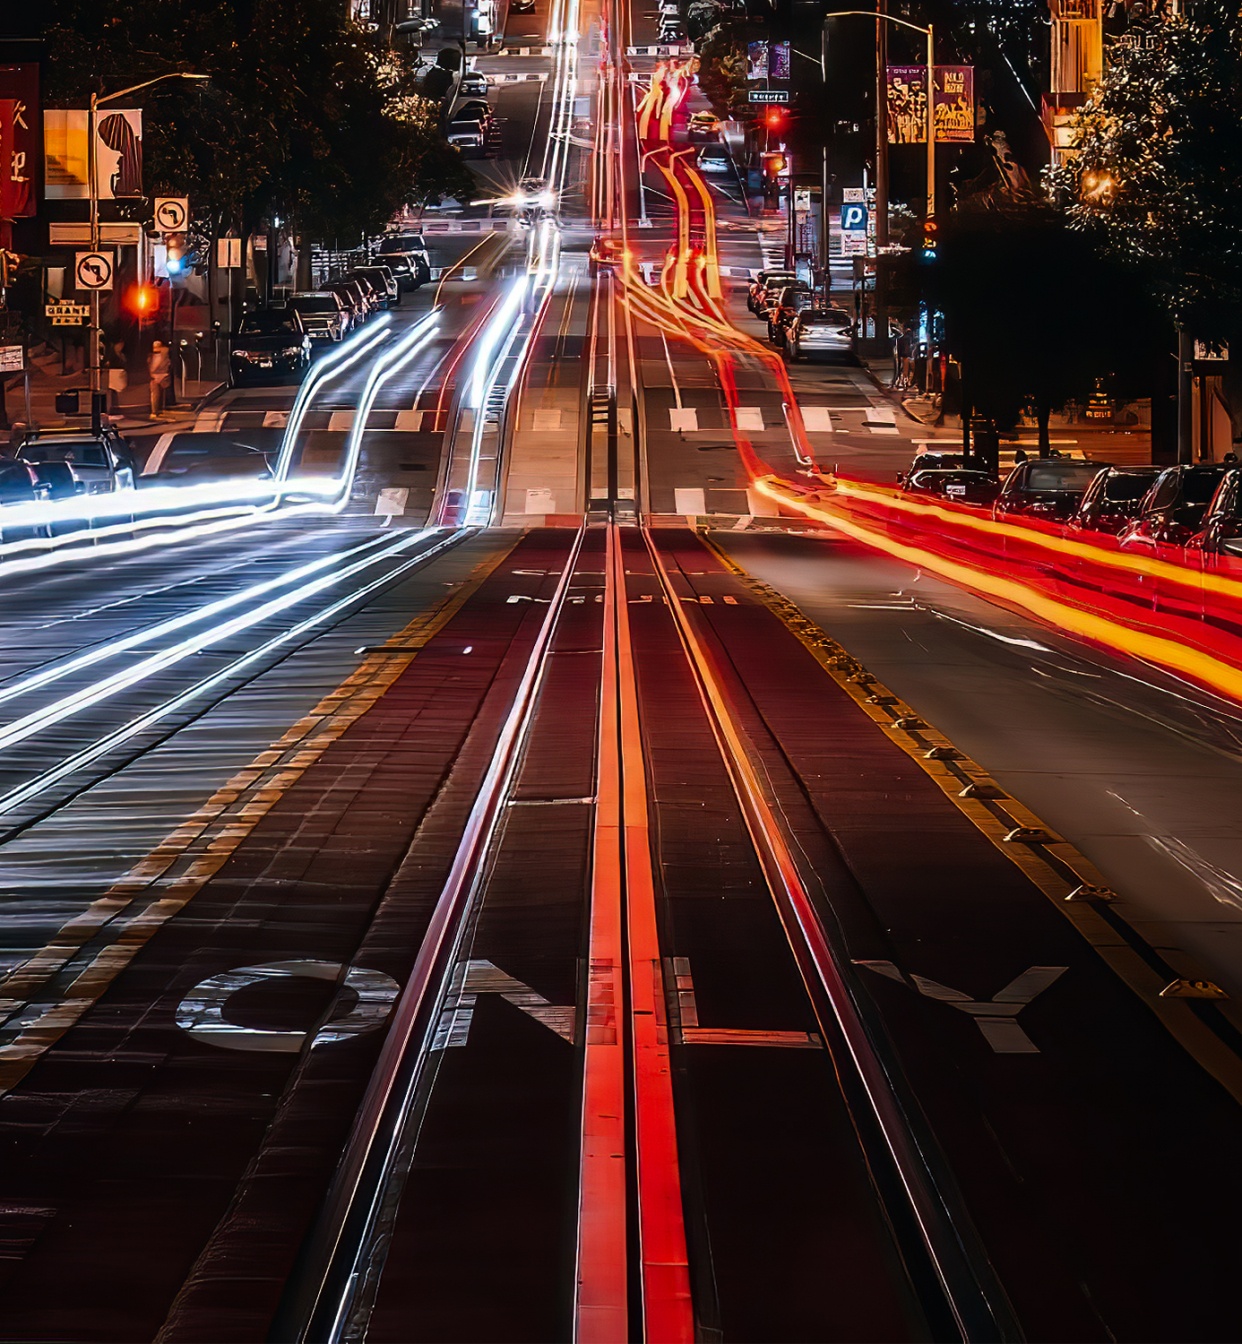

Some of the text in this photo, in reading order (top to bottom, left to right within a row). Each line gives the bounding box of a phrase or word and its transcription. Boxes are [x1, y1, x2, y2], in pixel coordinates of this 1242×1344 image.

[844, 207, 863, 229] P
[48, 306, 86, 315] GRANT
[174, 957, 1071, 1055] ONLY
